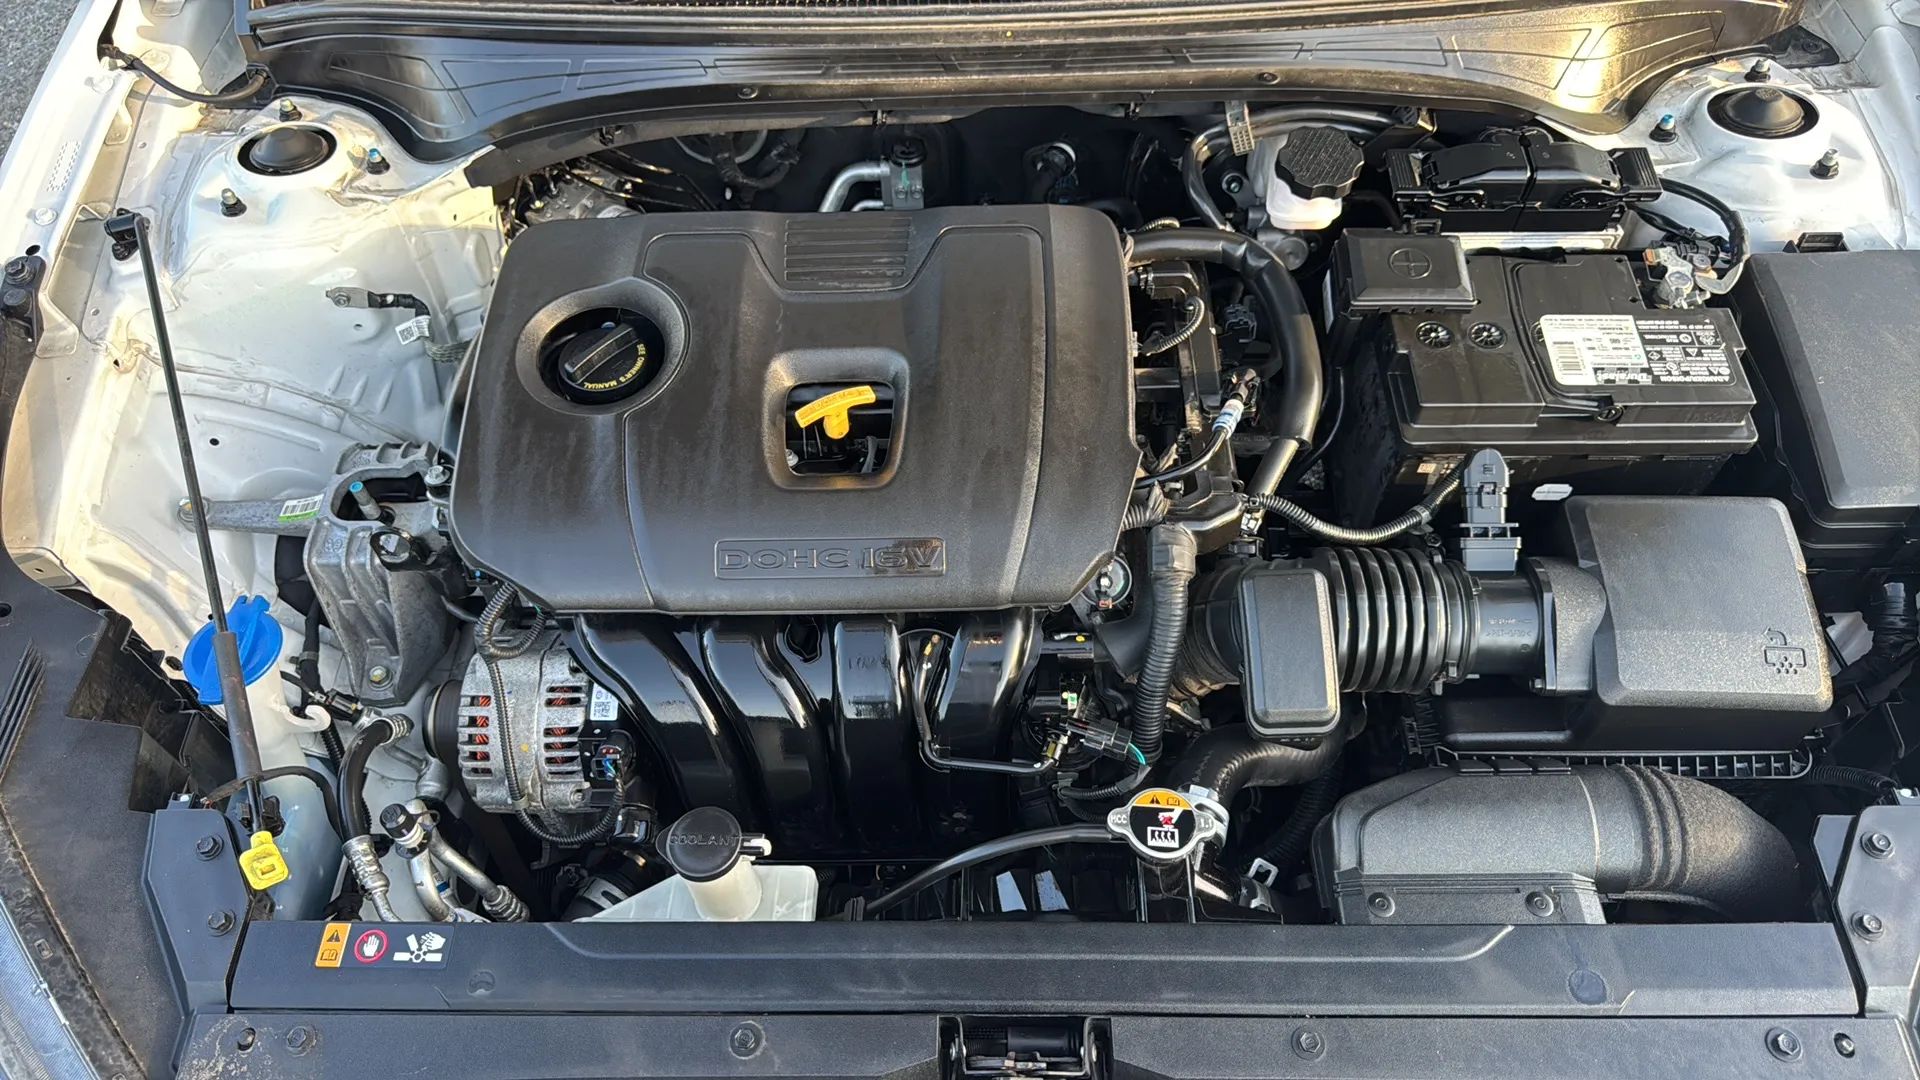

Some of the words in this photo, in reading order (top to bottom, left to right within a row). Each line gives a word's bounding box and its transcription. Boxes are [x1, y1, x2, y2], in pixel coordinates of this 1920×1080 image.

[636, 343, 646, 355] SEE
[619, 356, 645, 382] OWNER'S
[1596, 370, 1648, 381] Duralast
[584, 380, 617, 389] MANUAL
[719, 547, 849, 570] DOHC
[860, 546, 941, 571] 16V
[669, 833, 739, 847] COOLANT
